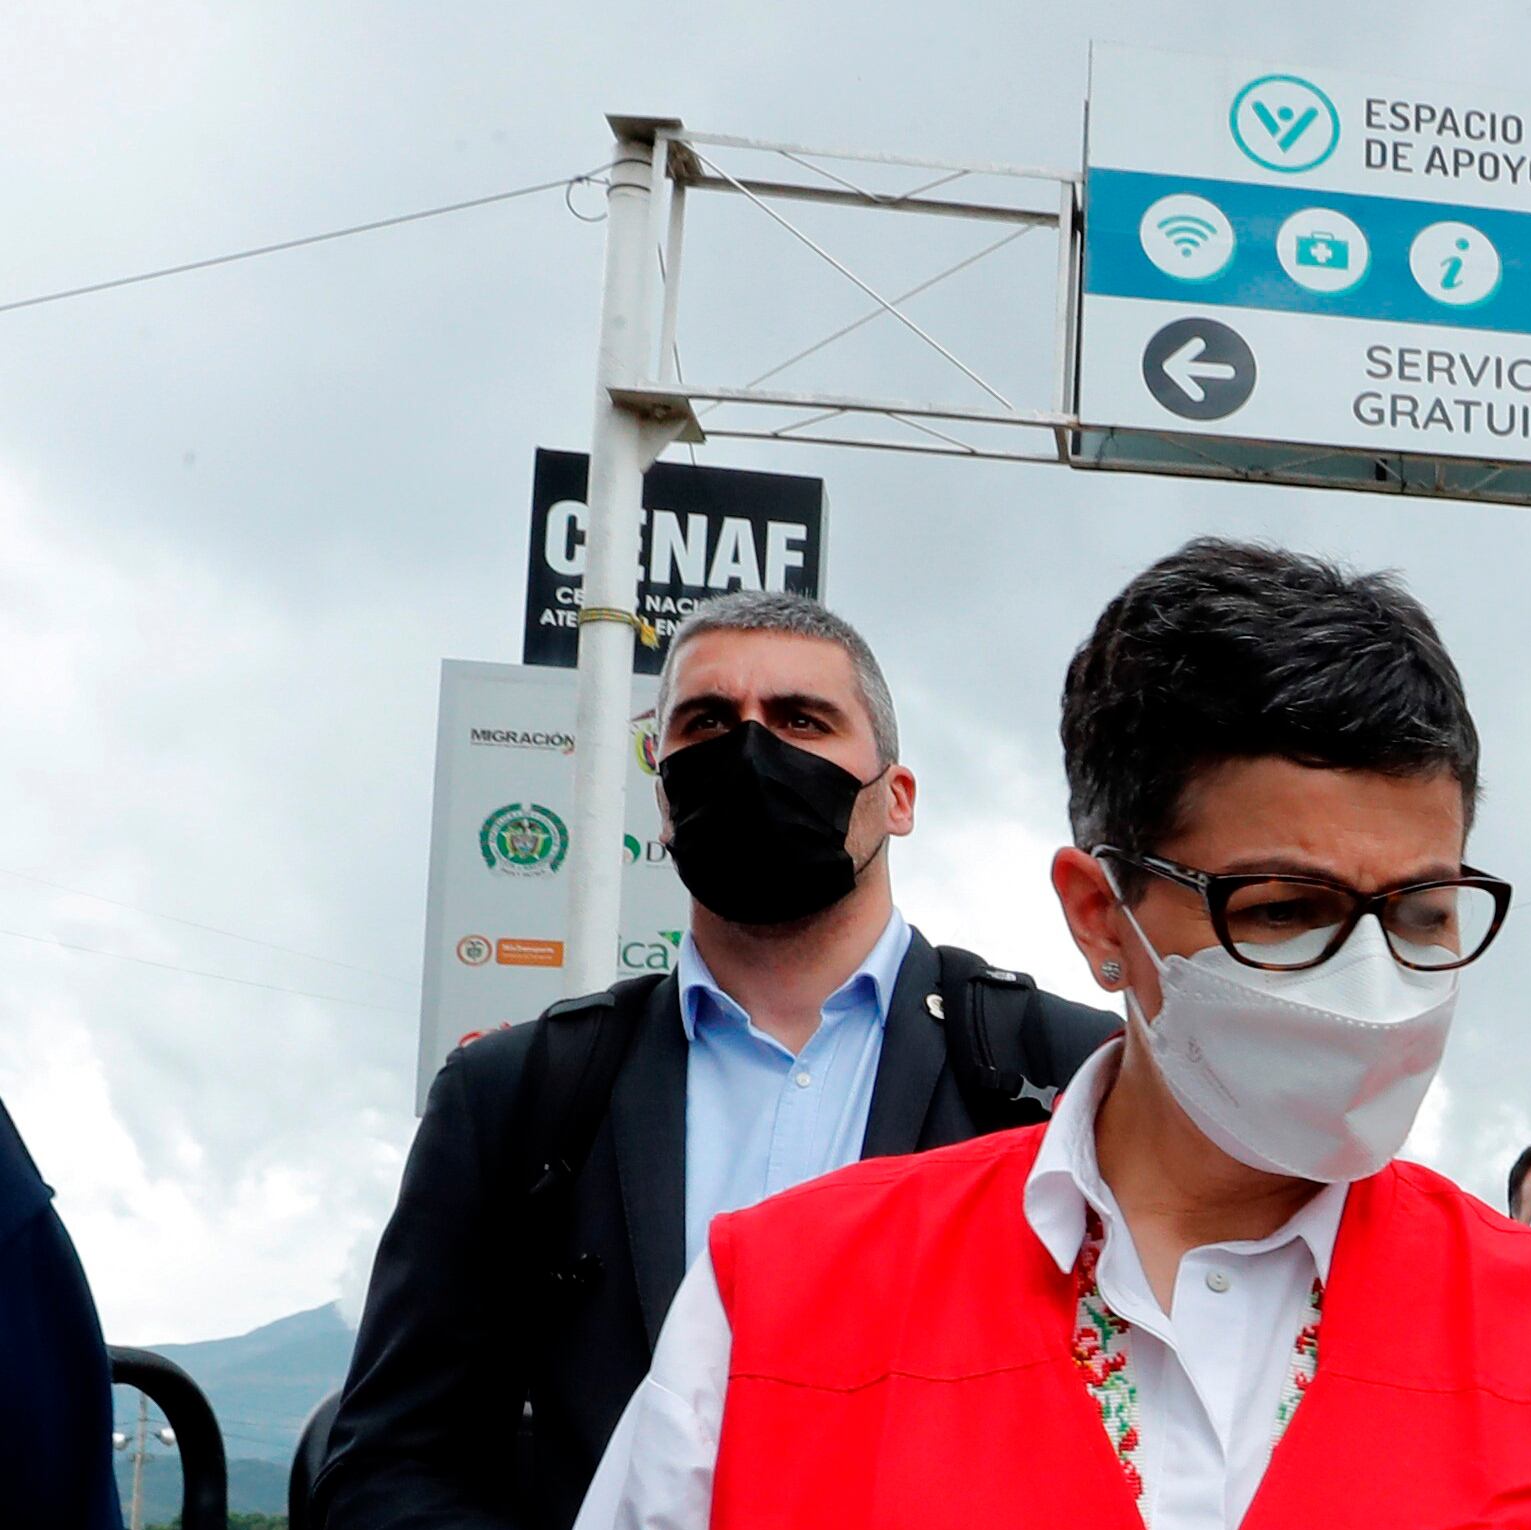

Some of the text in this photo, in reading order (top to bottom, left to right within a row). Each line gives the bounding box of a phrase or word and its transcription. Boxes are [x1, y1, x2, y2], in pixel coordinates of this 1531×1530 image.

[1364, 98, 1524, 145] ESPACIO
[1364, 138, 1413, 173] DE
[545, 499, 807, 592] CNAF
